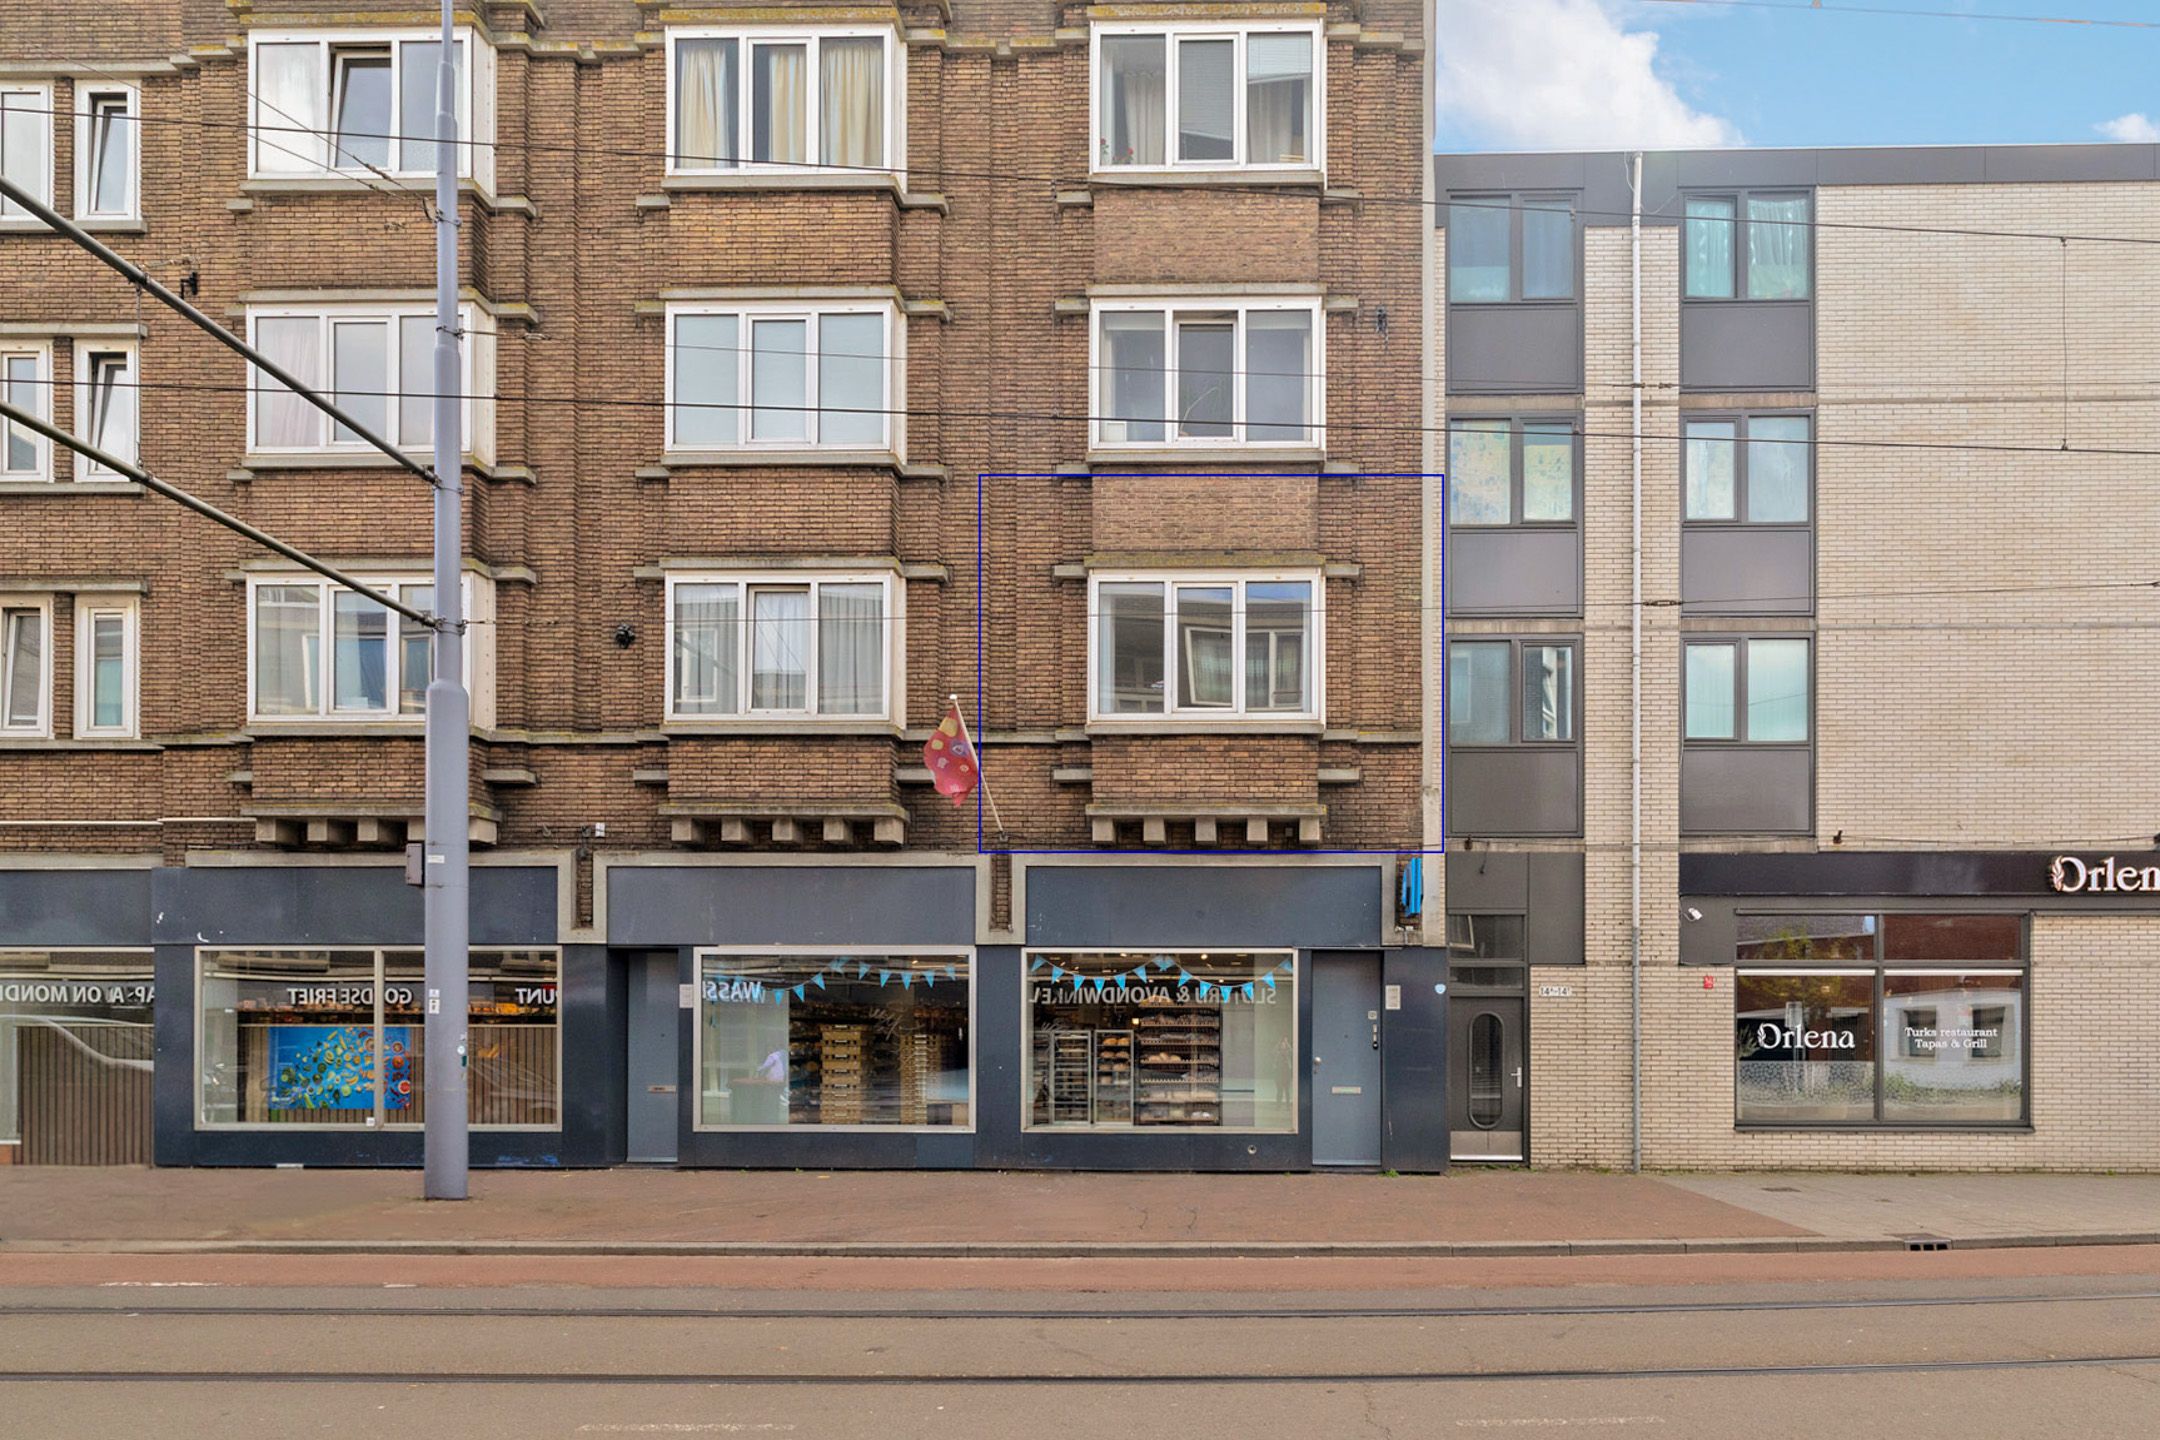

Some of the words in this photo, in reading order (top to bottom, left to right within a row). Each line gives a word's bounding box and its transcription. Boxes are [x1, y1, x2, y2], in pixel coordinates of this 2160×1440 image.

[2050, 855, 2160, 892] Orlen
[1757, 1022, 1856, 1050] Orlena
[1904, 1026, 1937, 1038] Turks
[1940, 1027, 1998, 1038] restaurant
[1914, 1038, 1948, 1051] Tapas
[1950, 1039, 1961, 1049] &
[1963, 1038, 1988, 1049] Grill
